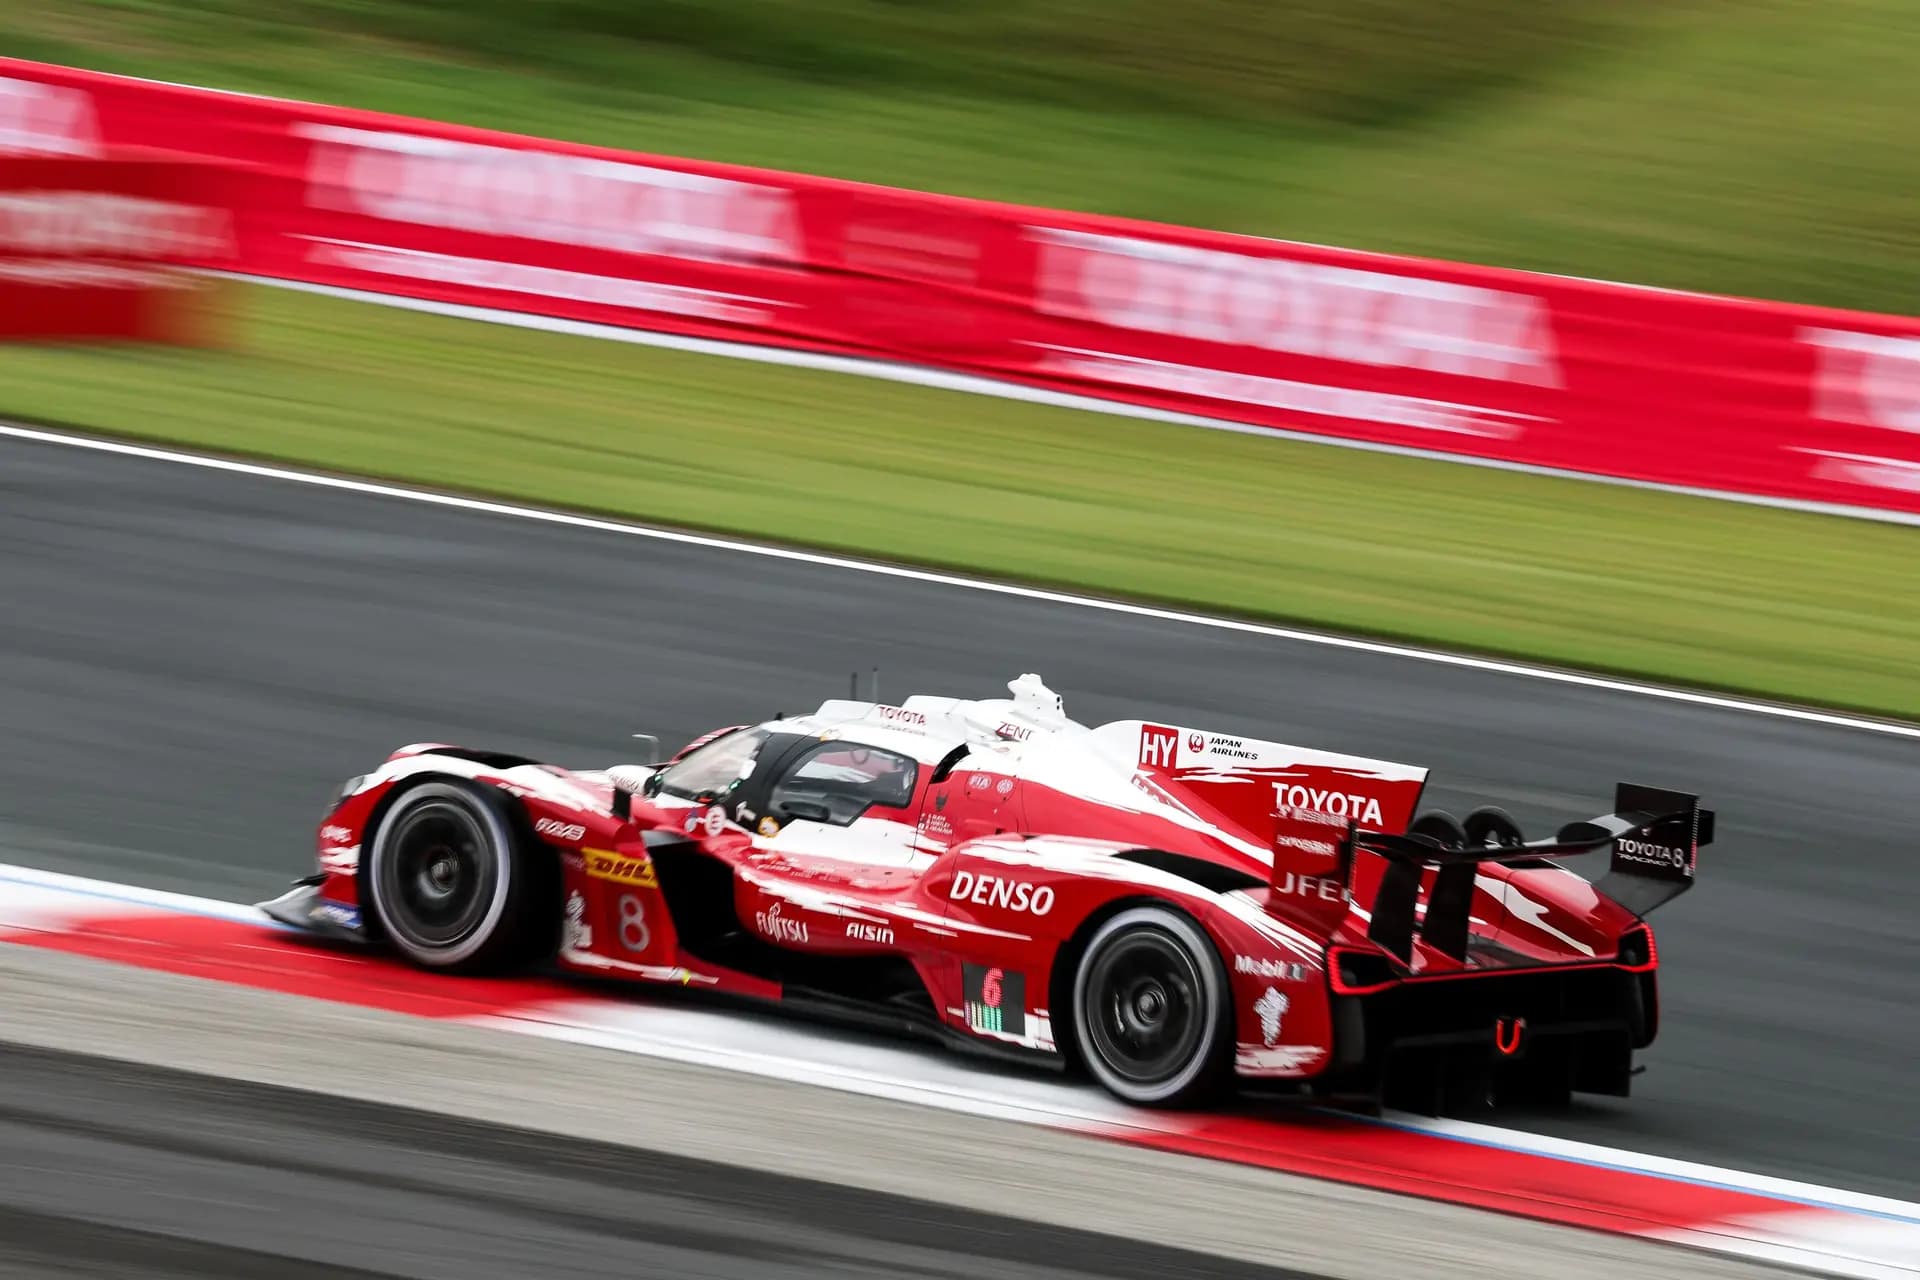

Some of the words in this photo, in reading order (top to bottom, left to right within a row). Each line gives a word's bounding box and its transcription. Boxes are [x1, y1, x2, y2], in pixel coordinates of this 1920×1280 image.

[878, 705, 927, 726] TOYOTA
[996, 721, 1034, 741] ZENT
[1141, 731, 1177, 768] HY
[1209, 737, 1242, 748] JAPAN
[1210, 747, 1259, 761] AIRLINES
[1272, 781, 1384, 827] TOYOTA
[594, 857, 653, 881] DHL
[1616, 838, 1672, 860] TOYOTA
[1672, 847, 1685, 868] 8
[950, 870, 1055, 916] DENSO
[1275, 871, 1341, 903] JFE
[619, 894, 650, 952] 8
[755, 902, 809, 944] FUJITSU
[982, 967, 1004, 1008] 6
